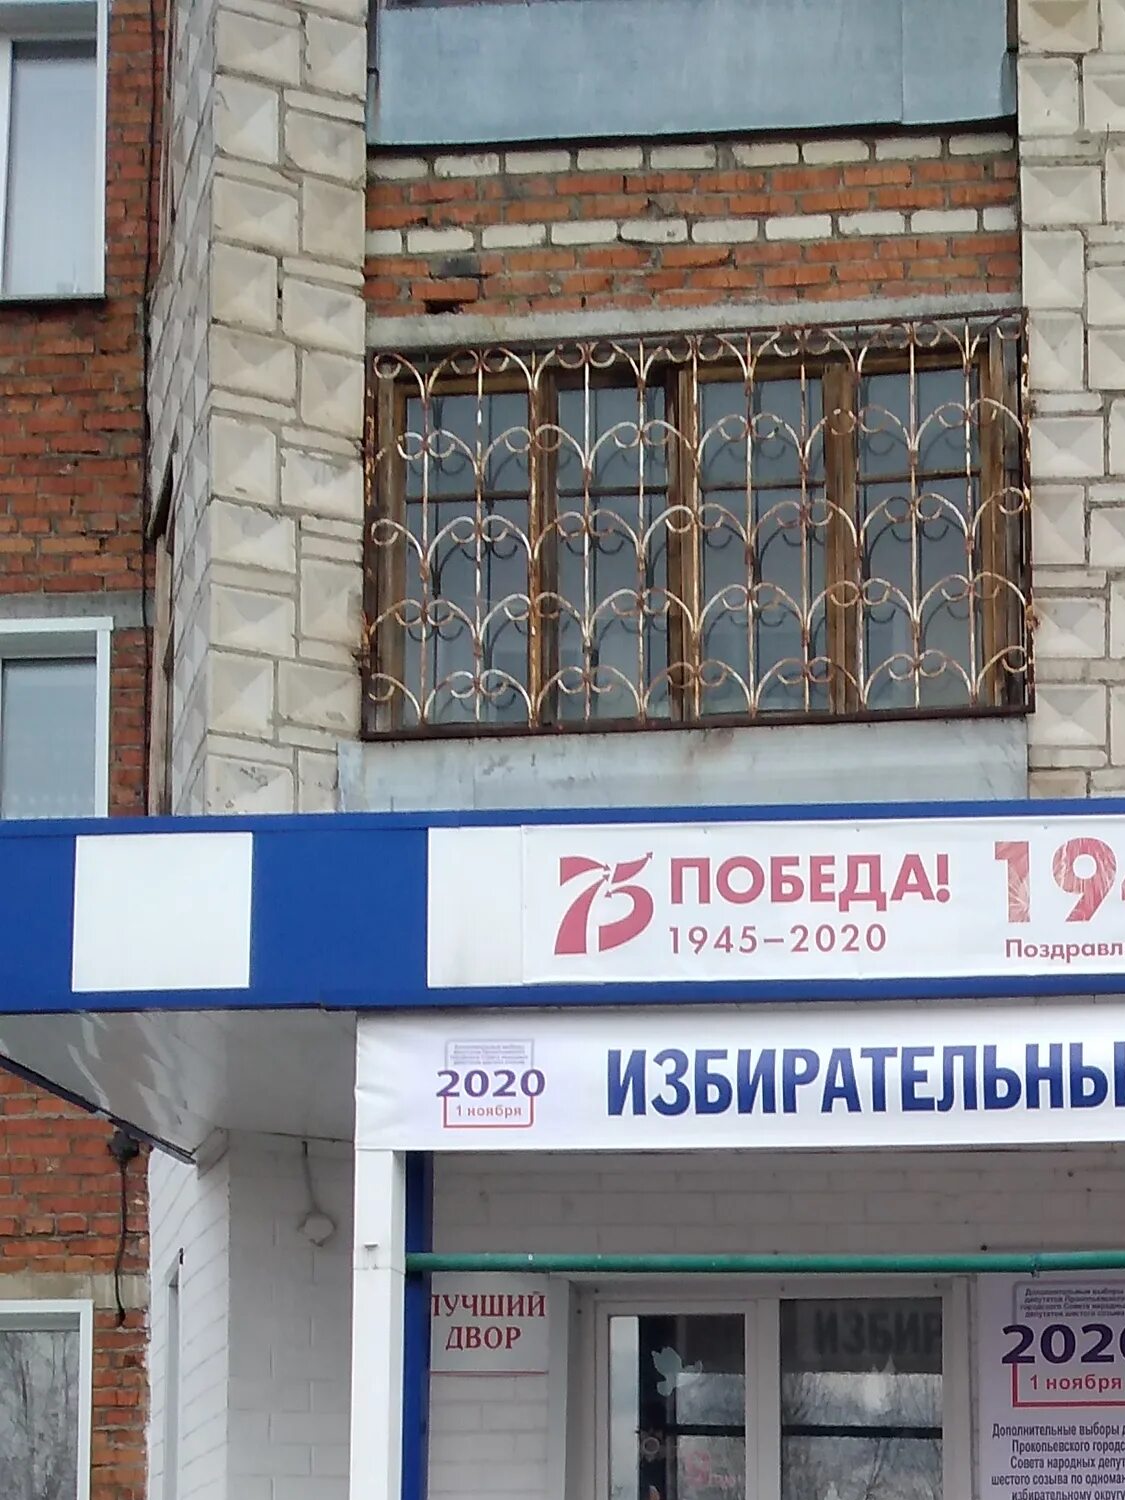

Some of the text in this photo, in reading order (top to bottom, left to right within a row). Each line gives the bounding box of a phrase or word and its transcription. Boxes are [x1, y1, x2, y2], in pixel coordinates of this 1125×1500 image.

[670, 852, 952, 913] ПОБЕДА!
[436, 1069, 546, 1097] 2020
[456, 1104, 522, 1119] 1 ноября
[445, 1326, 522, 1351] ДВОР
[1030, 1374, 1122, 1393] 1 ноября
[992, 1423, 1077, 1439] Дополнительные
[1079, 1422, 1120, 1438] выборы
[1012, 1439, 1090, 1455] Прокопьевского
[1010, 1456, 1045, 1470] Совета
[1047, 1456, 1096, 1471] народных
[991, 1474, 1031, 1486] шестого
[1033, 1473, 1068, 1485] созыва
[1071, 1473, 1083, 1485] по
